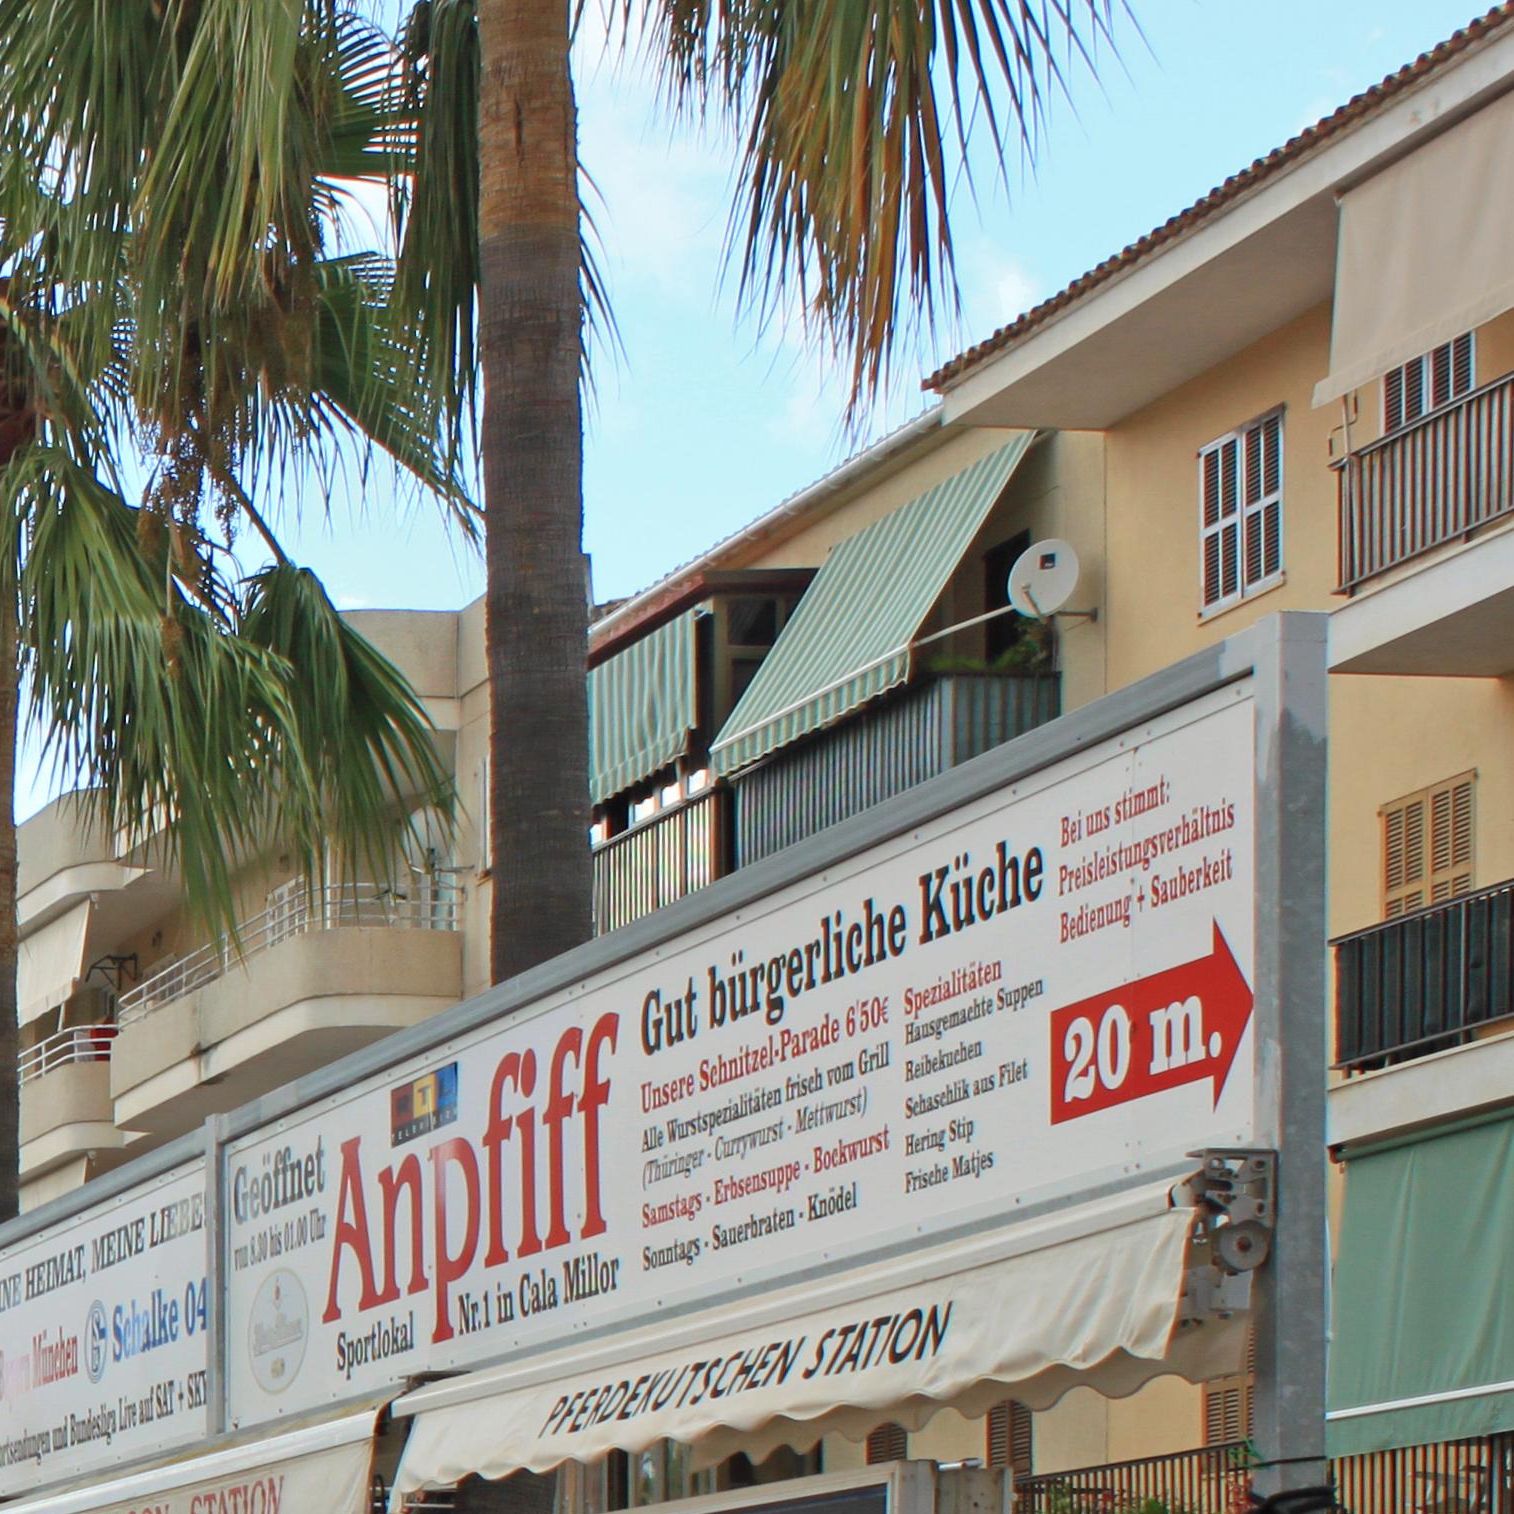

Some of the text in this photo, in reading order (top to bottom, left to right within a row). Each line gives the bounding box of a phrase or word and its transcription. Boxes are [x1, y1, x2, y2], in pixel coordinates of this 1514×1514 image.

[1058, 796, 1237, 897] Preisleistungsverhältnis
[1060, 773, 1172, 848] Bei uns stimmt:
[1060, 847, 1235, 944] Bedienung + Sauberkeit
[640, 838, 1045, 1057] Gut bürgerliche Küche
[903, 959, 1003, 1020] Spezialitäten
[904, 978, 1045, 1046] Hausgemachte Suppen
[1064, 993, 1223, 1104] 20 m.
[640, 1072, 695, 1114] Unsere
[698, 1012, 841, 1092] Schnitzel-Parade
[641, 1041, 892, 1154] Alle Wurstspezialitäten frisch vom Grill
[904, 1039, 983, 1083] Reibekuchen
[904, 1057, 1029, 1120] Schaschlik aus Filet
[233, 1135, 326, 1226] Geöffnet
[322, 1011, 620, 1344] Anpfiff
[641, 1148, 706, 1192] (Thüringer
[714, 1119, 785, 1162] Currywurst
[794, 1085, 869, 1135] Mettwurst)
[641, 1190, 703, 1229] Samstags
[713, 1160, 802, 1206] Erbsensuppe
[812, 1122, 892, 1174] Bockwurst
[903, 1151, 995, 1195] Frische Matjes
[904, 1116, 975, 1157] Hering Stip
[24, 1244, 87, 1302] HEIMAT,
[90, 1217, 145, 1275] MEINE
[309, 1206, 326, 1248] Uhr
[642, 1236, 701, 1272] Sonntags
[712, 1206, 796, 1251] Sauerbraten
[806, 1181, 858, 1222] Knödel
[112, 1286, 180, 1364] Schalke
[183, 1276, 208, 1338] 04
[496, 1282, 515, 1325] in
[519, 1268, 559, 1318] Cala
[562, 1254, 620, 1305] Millor
[336, 1310, 415, 1381] Sportlokal
[538, 1300, 953, 1440] PFERDEKUTSCHEN STATION
